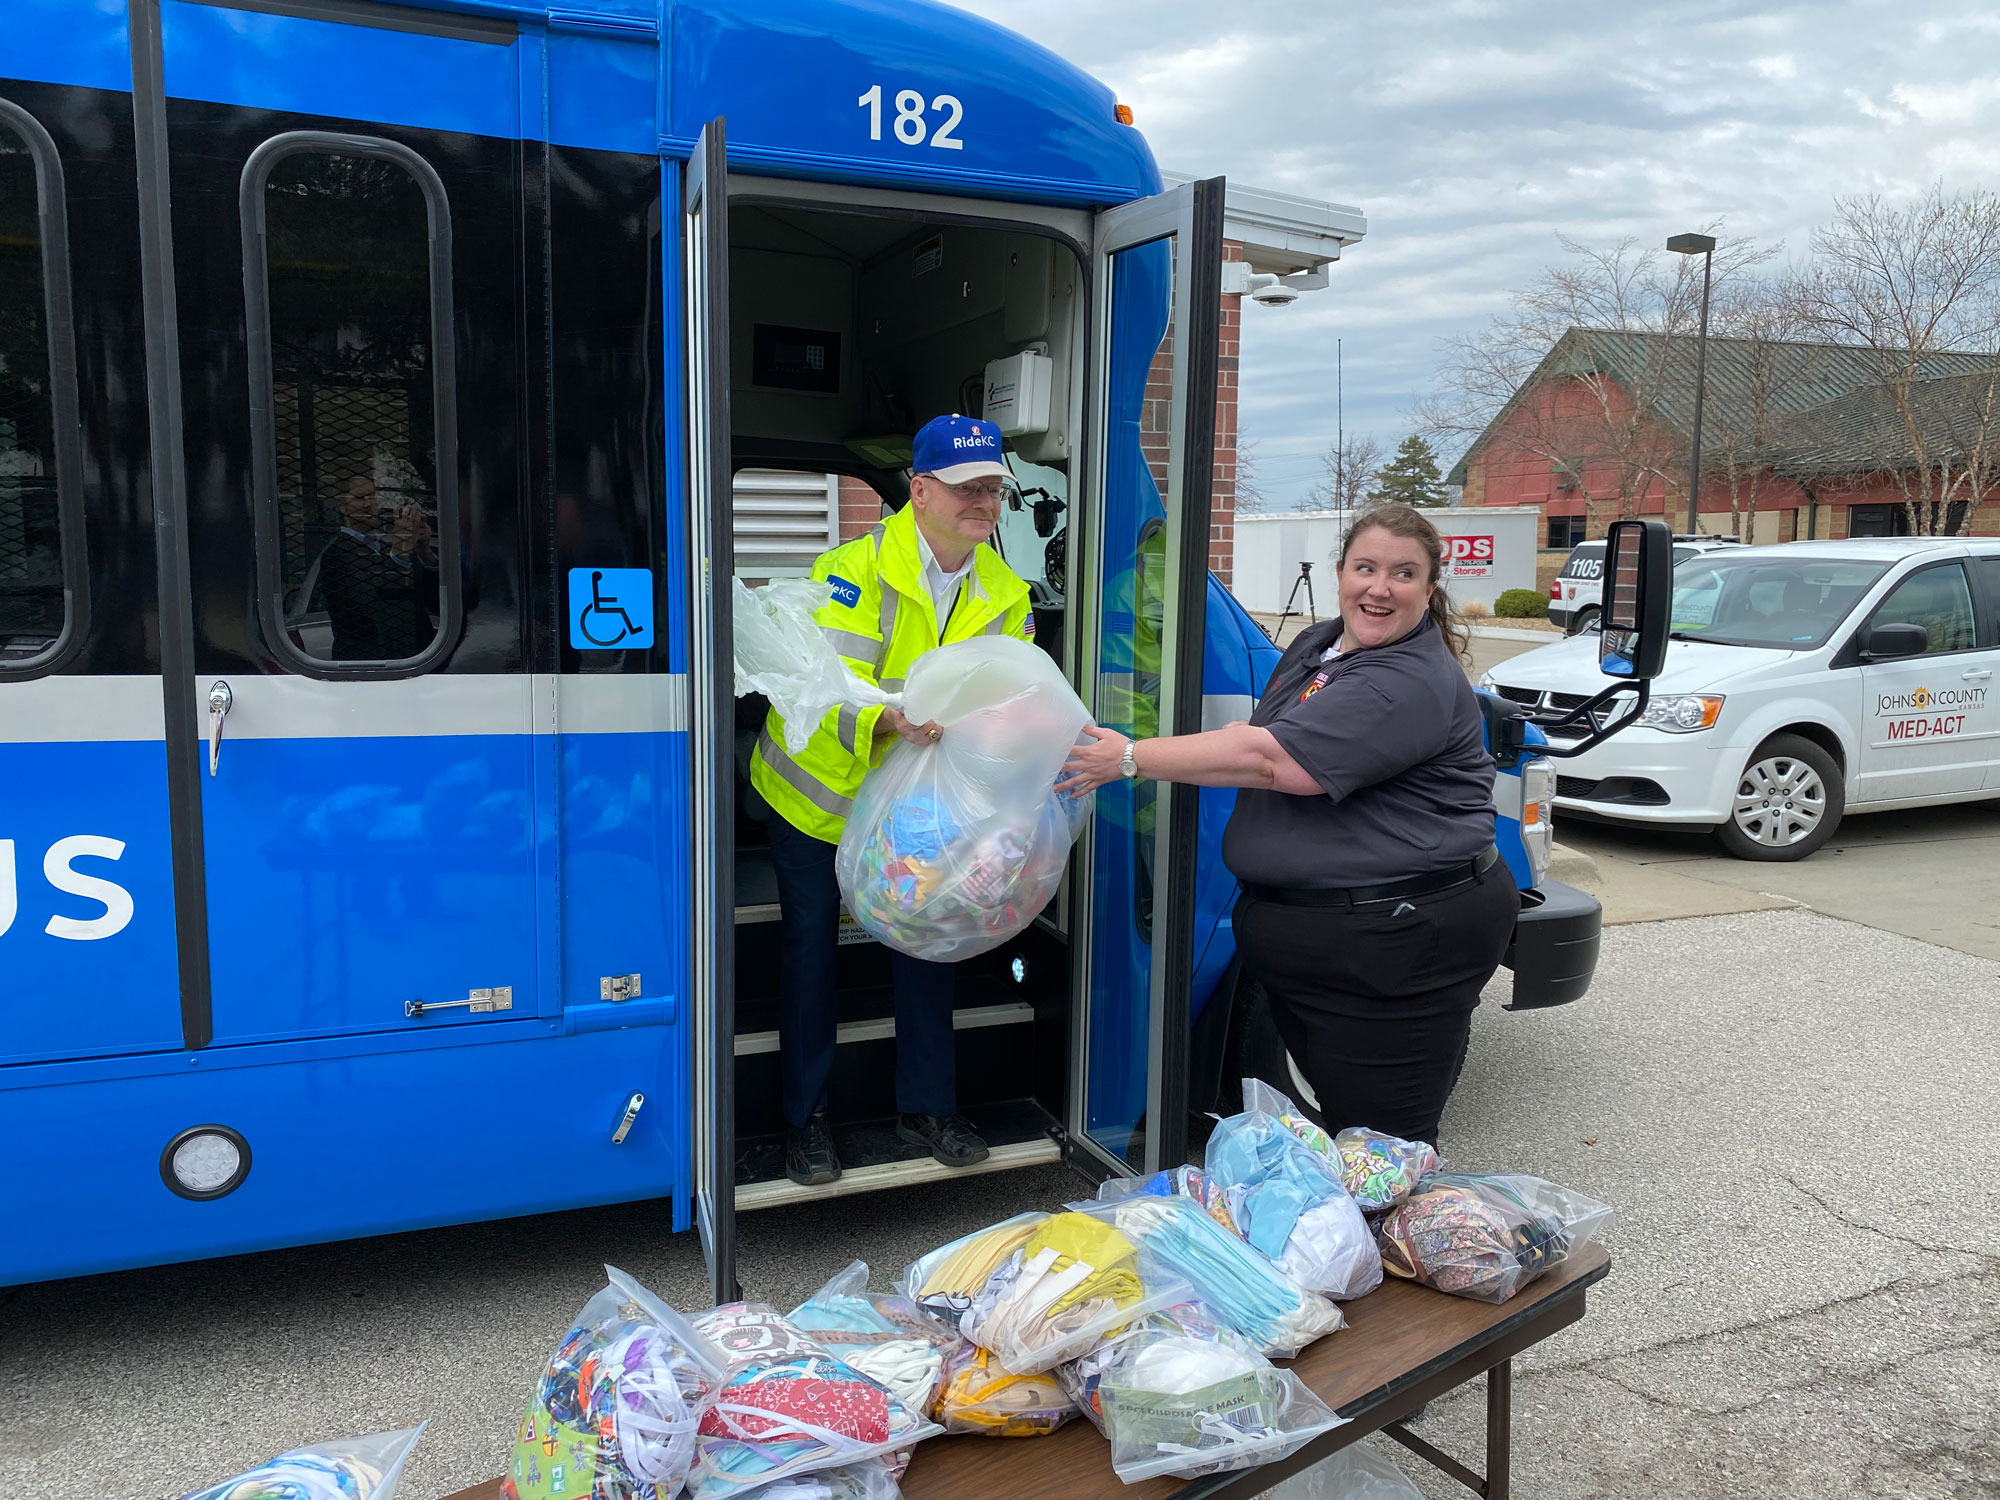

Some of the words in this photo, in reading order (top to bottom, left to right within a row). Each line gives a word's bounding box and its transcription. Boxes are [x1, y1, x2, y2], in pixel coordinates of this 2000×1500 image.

[858, 84, 963, 150] 182
[953, 435, 996, 449] RideKC
[1453, 566, 1487, 577] Storage
[1570, 558, 1603, 578] 1105
[1874, 691, 1937, 716] JOHNSON
[1938, 688, 1988, 704] COUNTY
[1959, 703, 1985, 711] KANSAS
[1888, 715, 1966, 740] MED-ACT
[0, 834, 134, 941] S
[1215, 1395, 1245, 1411] MASK
